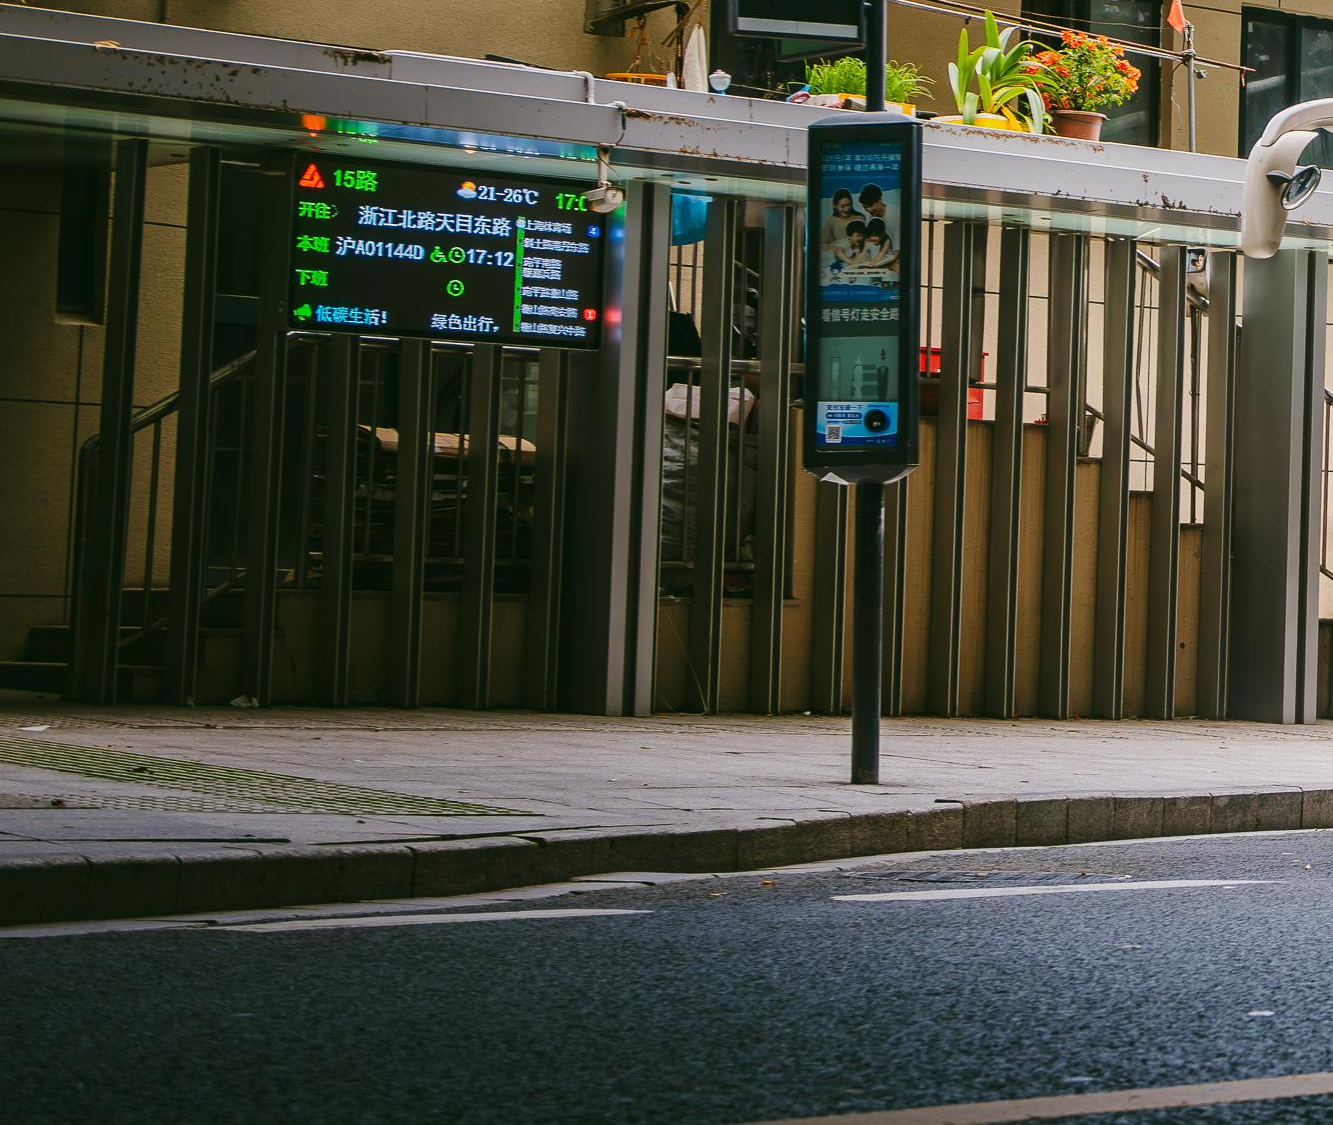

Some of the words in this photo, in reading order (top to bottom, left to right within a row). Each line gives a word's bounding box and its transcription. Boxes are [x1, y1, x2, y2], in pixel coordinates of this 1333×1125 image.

[333, 170, 379, 192] 15路
[298, 202, 331, 220] 开往
[358, 205, 513, 237] 浙江北路天目东路
[296, 234, 330, 253] 本班
[335, 236, 425, 261] 沪A01144D
[466, 248, 515, 268] 17:12
[295, 269, 329, 287] 下班
[315, 305, 388, 326] 低碳生活！
[431, 313, 501, 333] 绿色出行，
